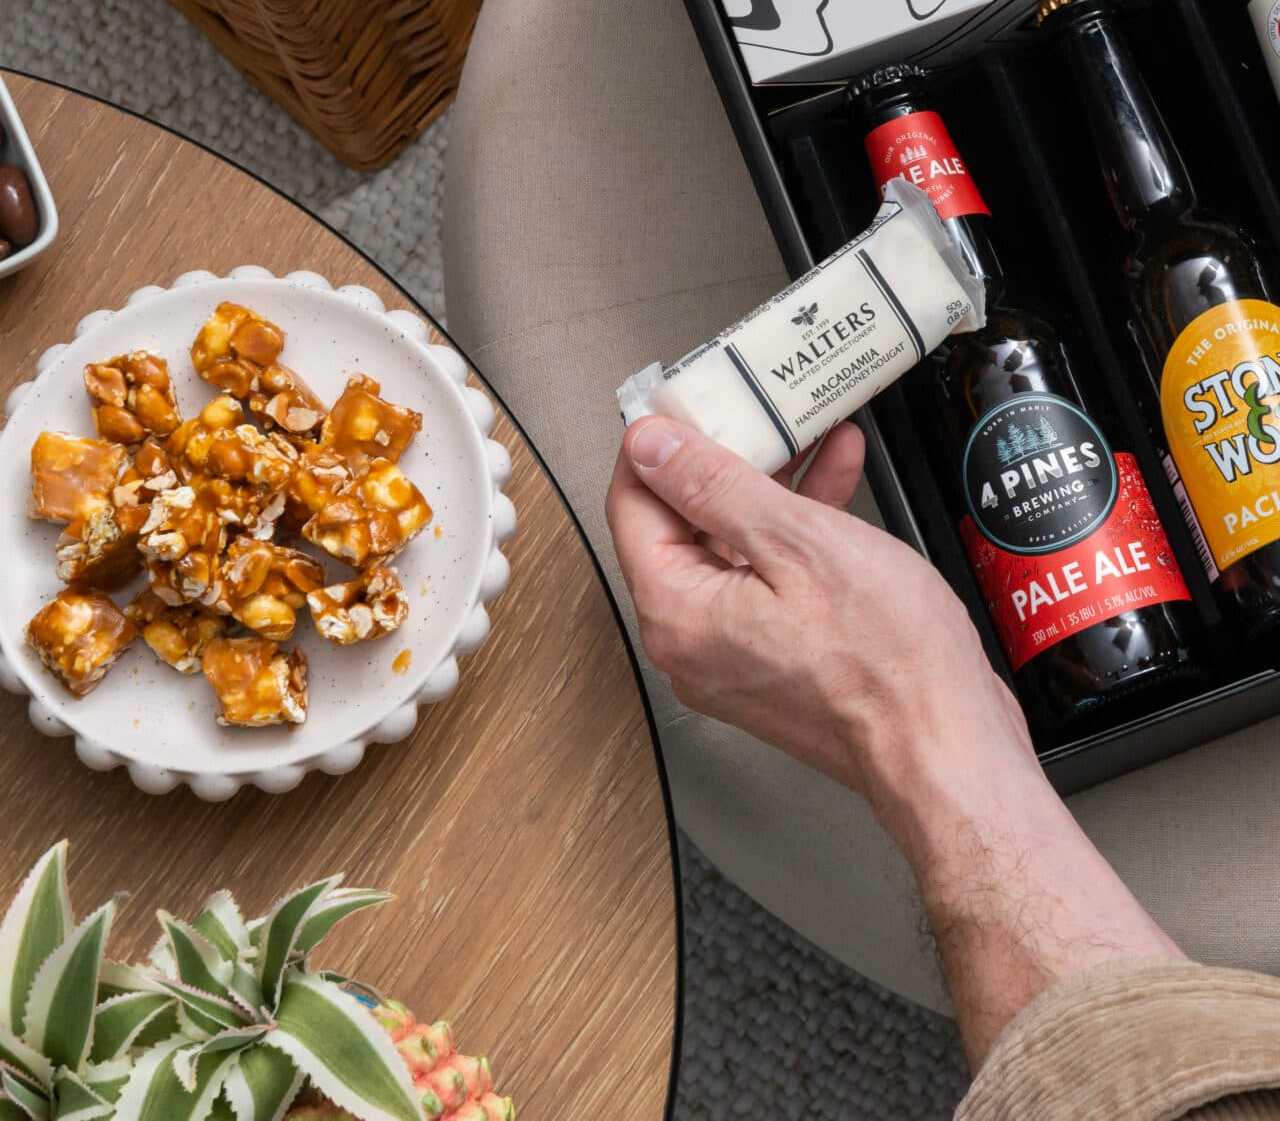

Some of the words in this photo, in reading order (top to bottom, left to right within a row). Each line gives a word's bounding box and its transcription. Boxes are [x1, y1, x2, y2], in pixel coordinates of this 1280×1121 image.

[896, 131, 938, 146] ORIGINAL
[929, 157, 966, 180] ALE
[945, 299, 963, 315] 50g
[769, 301, 878, 385] WALTERS
[788, 363, 823, 391] CRAFTED
[820, 323, 878, 369] CONFECTIONERY
[1186, 338, 1213, 367] THE
[794, 388, 844, 429] HANDMADE
[842, 366, 872, 395] HONEY
[869, 340, 907, 373] NOUGAT
[809, 346, 881, 403] MACADAMIA
[980, 481, 999, 509] 4
[1000, 441, 1101, 500] PINES
[1012, 478, 1085, 518] BREWING
[1027, 496, 1078, 522] COMPANY
[1010, 560, 1088, 622] PALE
[1094, 540, 1152, 585] ALE
[1031, 630, 1047, 646] 330
[1066, 612, 1079, 628] 35
[1078, 606, 1096, 622] IBU
[1124, 584, 1158, 605] ALC/VOL
